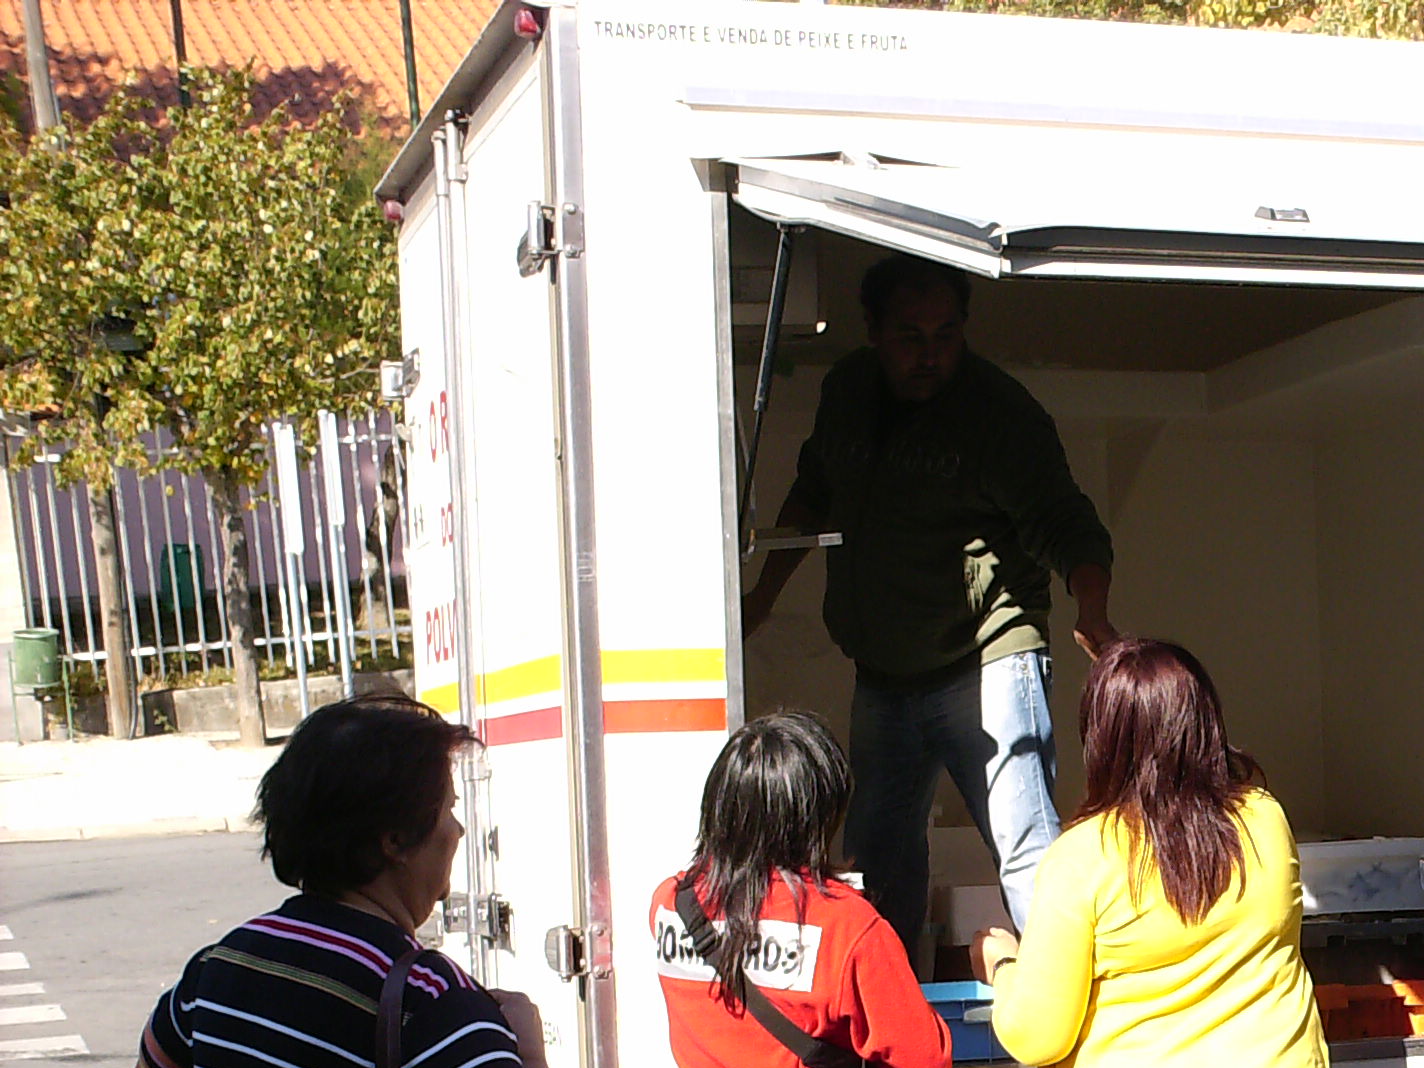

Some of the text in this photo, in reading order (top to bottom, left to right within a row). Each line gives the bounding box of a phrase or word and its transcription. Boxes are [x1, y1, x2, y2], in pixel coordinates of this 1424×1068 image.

[593, 20, 908, 51] TRANSPORTE E VENDA DE PEIXE E FRUTA
[656, 920, 802, 975] BOMROS
